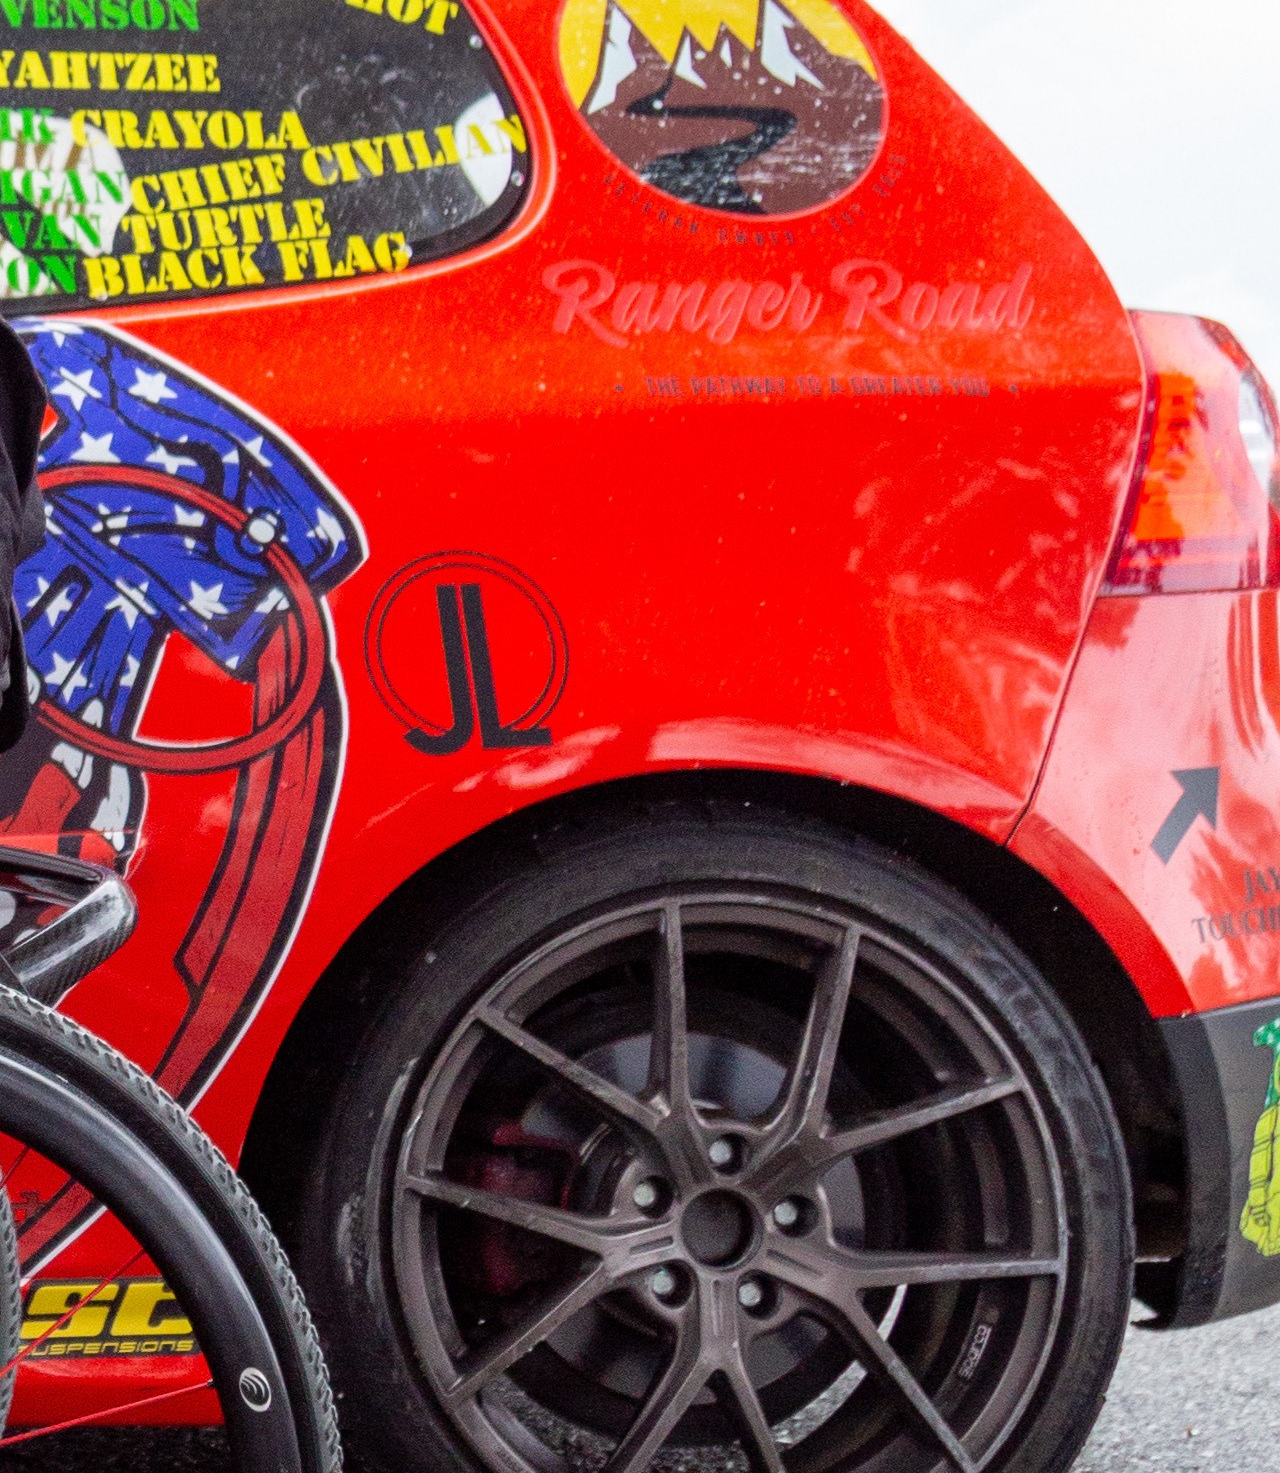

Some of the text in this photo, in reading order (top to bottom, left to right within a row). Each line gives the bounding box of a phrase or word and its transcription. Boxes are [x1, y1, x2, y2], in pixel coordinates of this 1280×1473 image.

[69, 108, 312, 151] CRAYOLA
[129, 112, 528, 215] CHIEF CIVILIAN
[121, 197, 333, 256] TURTLE
[81, 230, 411, 301] BLACK FLAG
[540, 256, 1037, 350] Ranger Road
[644, 376, 682, 397] THE
[689, 376, 786, 397] PATHWAY
[848, 376, 942, 397] GREATER
